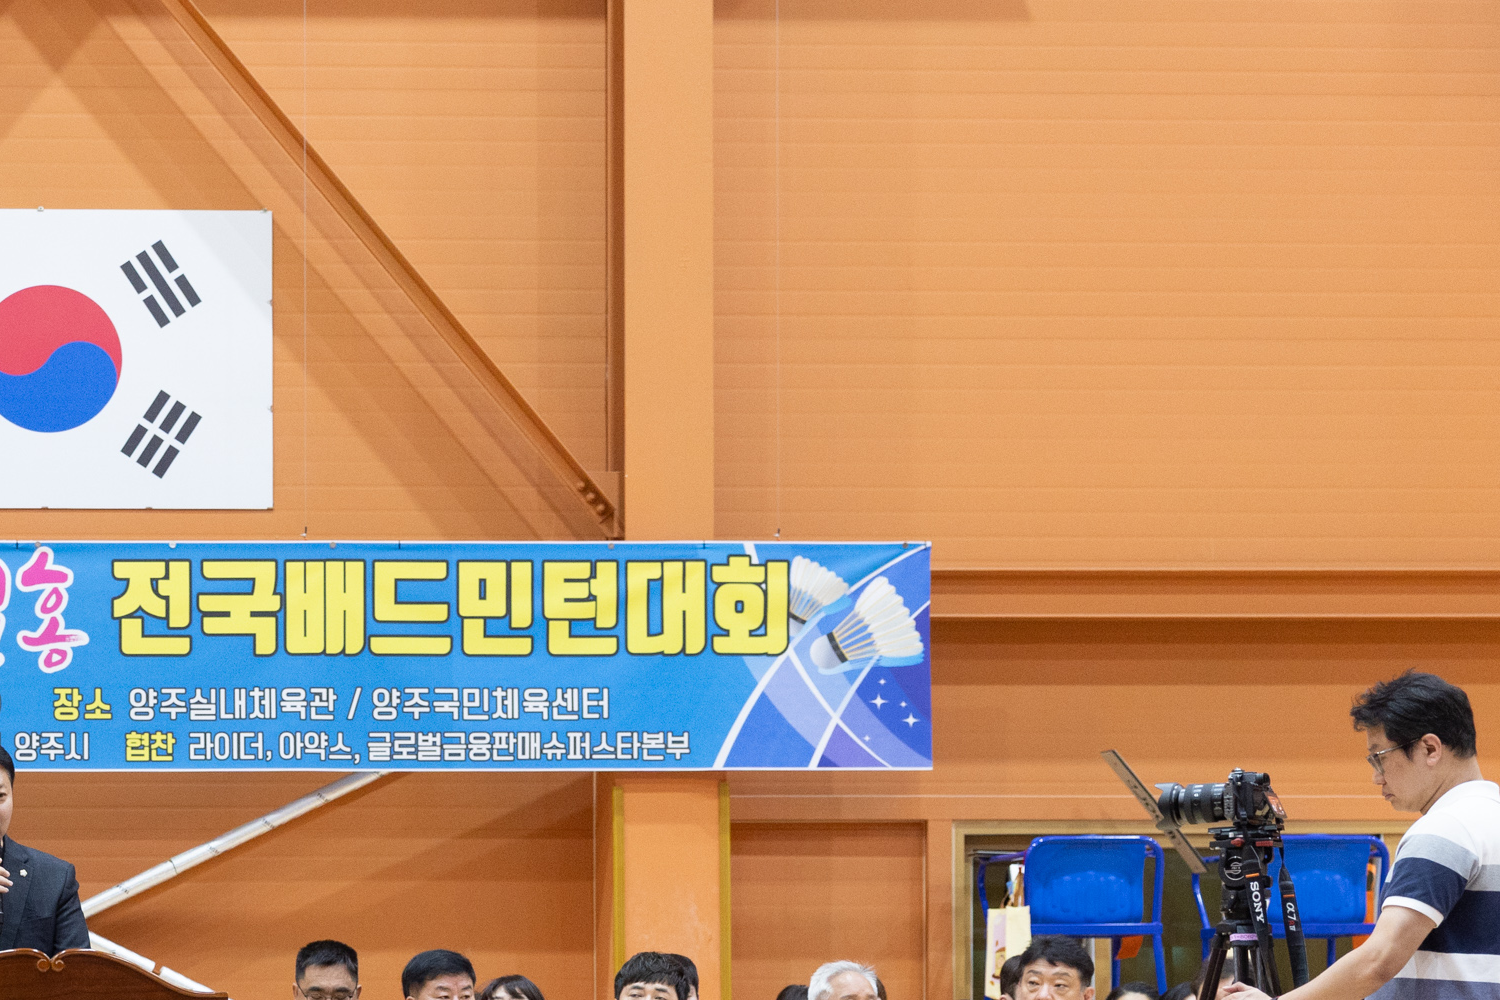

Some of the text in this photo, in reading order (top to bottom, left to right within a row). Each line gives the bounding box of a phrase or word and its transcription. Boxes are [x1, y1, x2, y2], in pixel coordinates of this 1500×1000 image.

[111, 555, 790, 657] 전국배드민턴대회
[52, 687, 113, 721] 장소
[128, 686, 337, 721] 양주실내체육관
[371, 686, 610, 721] 양주국민체육센터
[14, 731, 90, 761] 양주시
[125, 731, 176, 762] 협찬
[188, 732, 273, 762] 라이더,
[367, 731, 692, 762] 글로벌금융판매슈퍼스타본부
[1250, 881, 1265, 923] SONY
